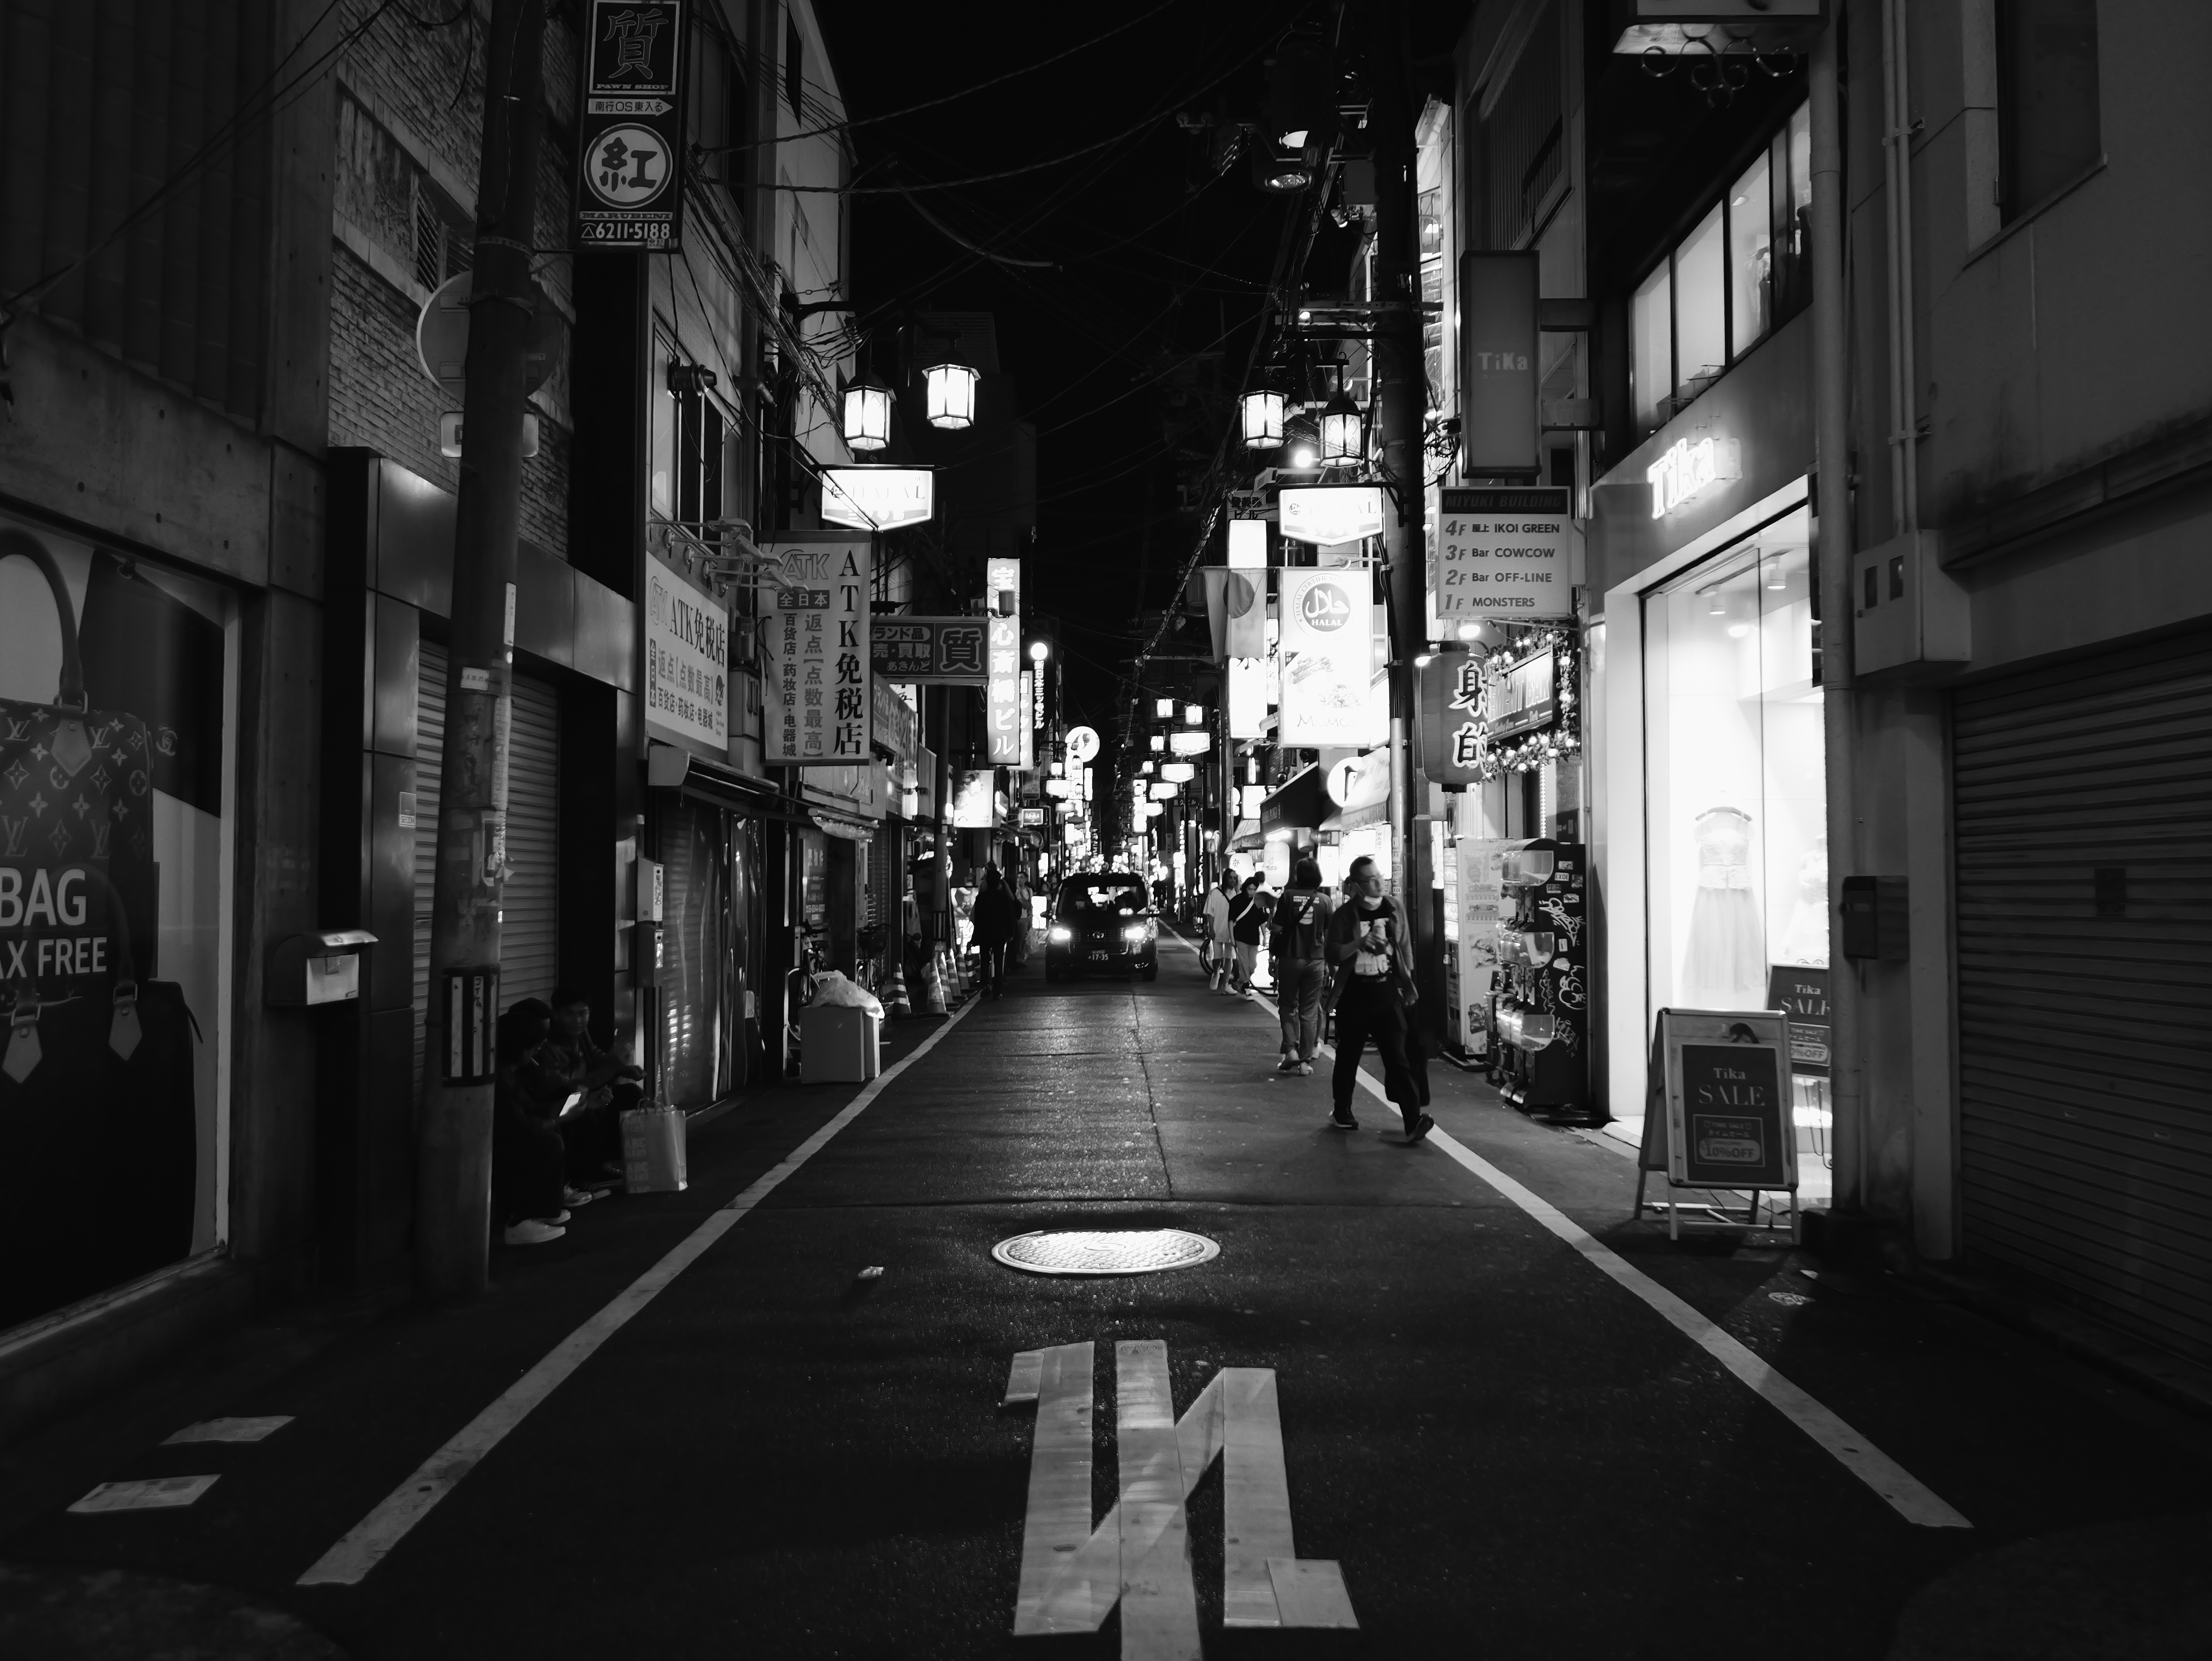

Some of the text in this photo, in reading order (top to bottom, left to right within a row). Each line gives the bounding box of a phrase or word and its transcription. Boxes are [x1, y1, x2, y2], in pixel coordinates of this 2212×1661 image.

[603, 8, 669, 79] 質
[595, 101, 664, 112] 南行OS東入る
[599, 136, 658, 192] 紅
[581, 212, 672, 220] MARUBENI
[1646, 437, 1717, 520] Tika
[1445, 495, 1562, 508] MIYUKI BUILDING
[1445, 519, 1560, 536] 4F 屋上 IKOI GREEN
[1445, 544, 1556, 561] 3F Bar COWCOW
[1445, 568, 1553, 585] 2F Bar OFF-LINE
[778, 592, 828, 607] 全日本
[1445, 594, 1535, 610] 1F MONSTERS
[939, 626, 983, 672] 質
[886, 660, 931, 672] あきんど
[990, 566, 1016, 756] 宝心斎橋ビル
[0, 867, 87, 927] BAG
[0, 936, 108, 979] X FREE
[1794, 984, 1821, 995] Tika
[1713, 1067, 1746, 1080] Tika
[1698, 1084, 1765, 1106] SALE
